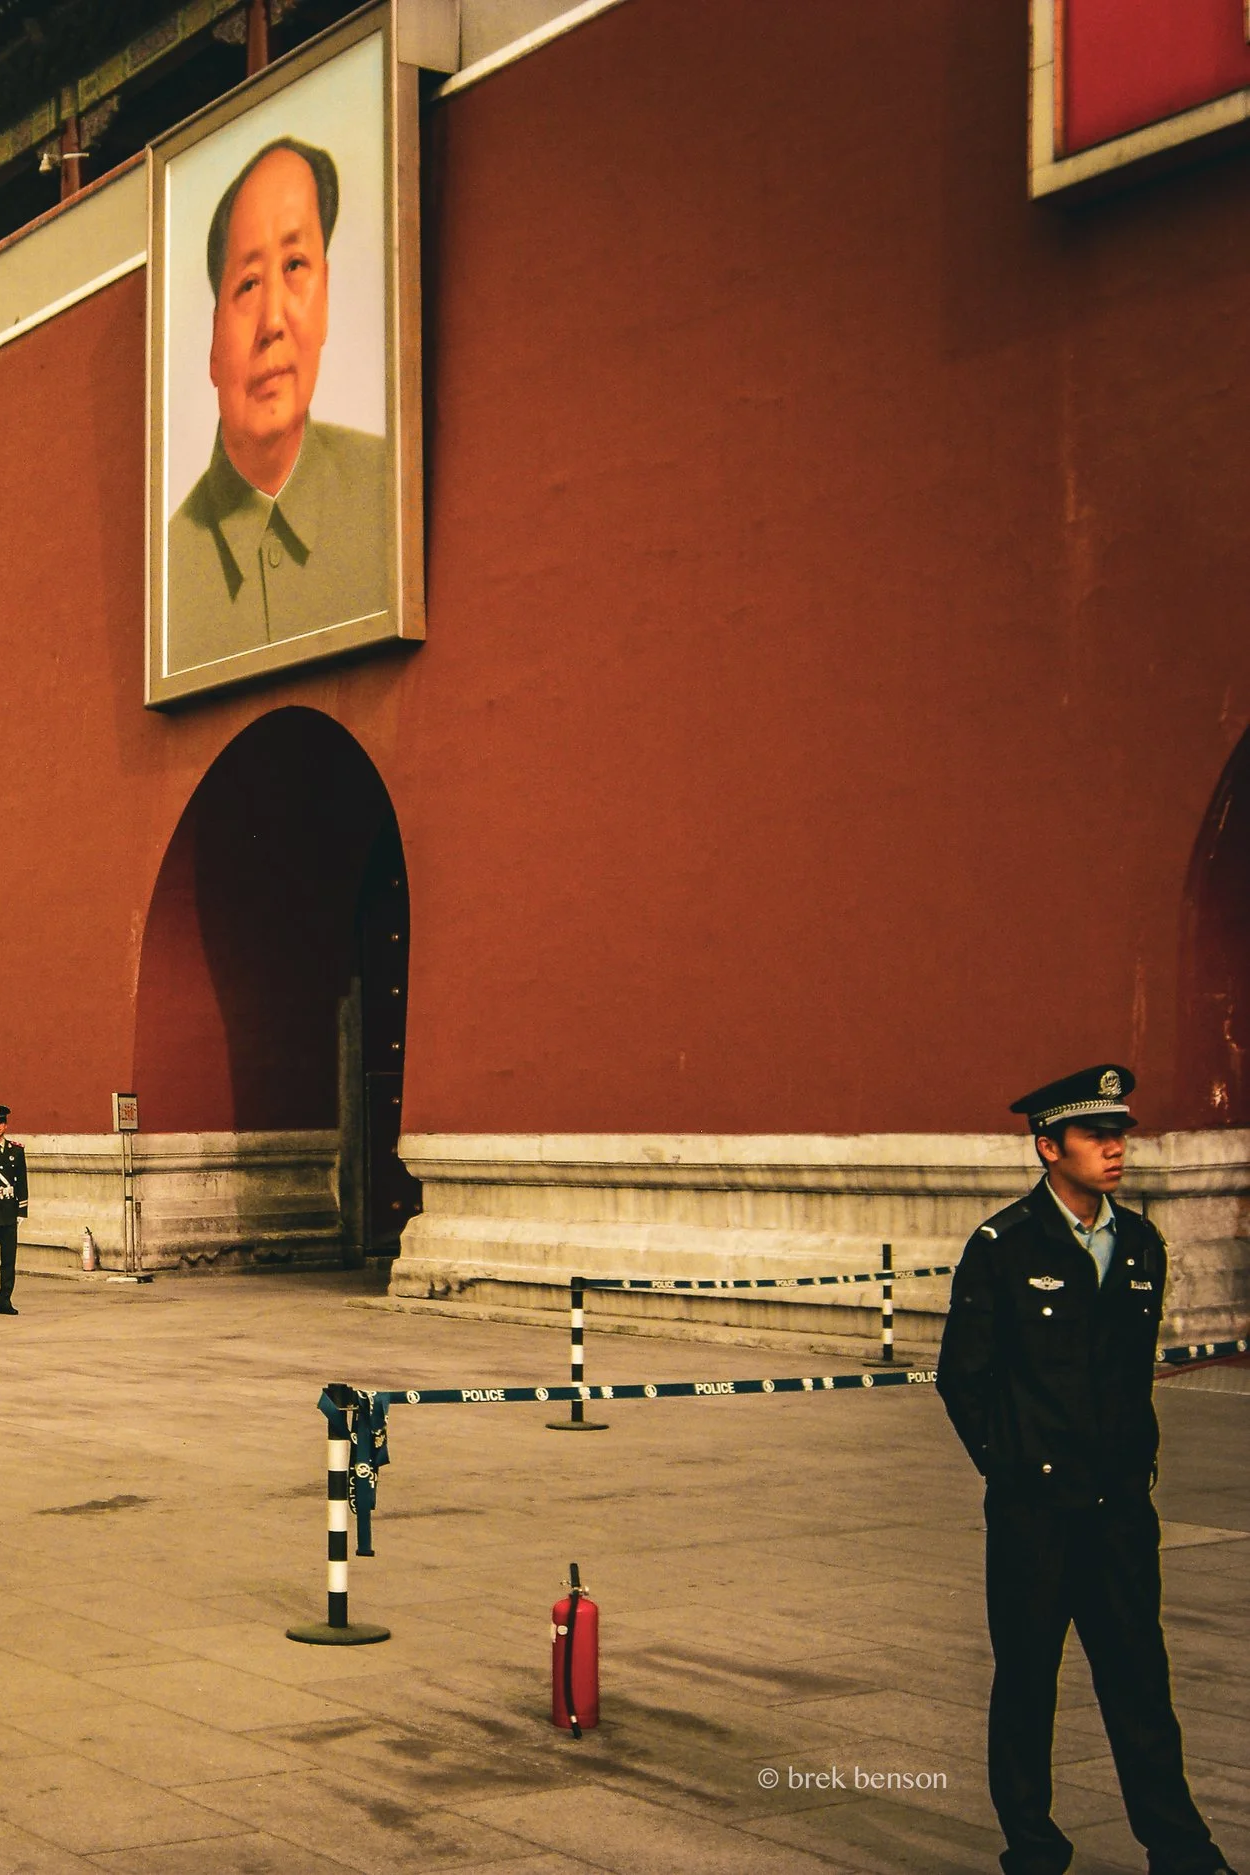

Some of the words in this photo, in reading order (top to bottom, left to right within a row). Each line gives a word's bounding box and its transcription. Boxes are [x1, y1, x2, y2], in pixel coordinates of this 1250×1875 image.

[461, 1389, 506, 1402] POLICE
[694, 1382, 736, 1395] POLICE
[907, 1371, 938, 1383] POLIC
